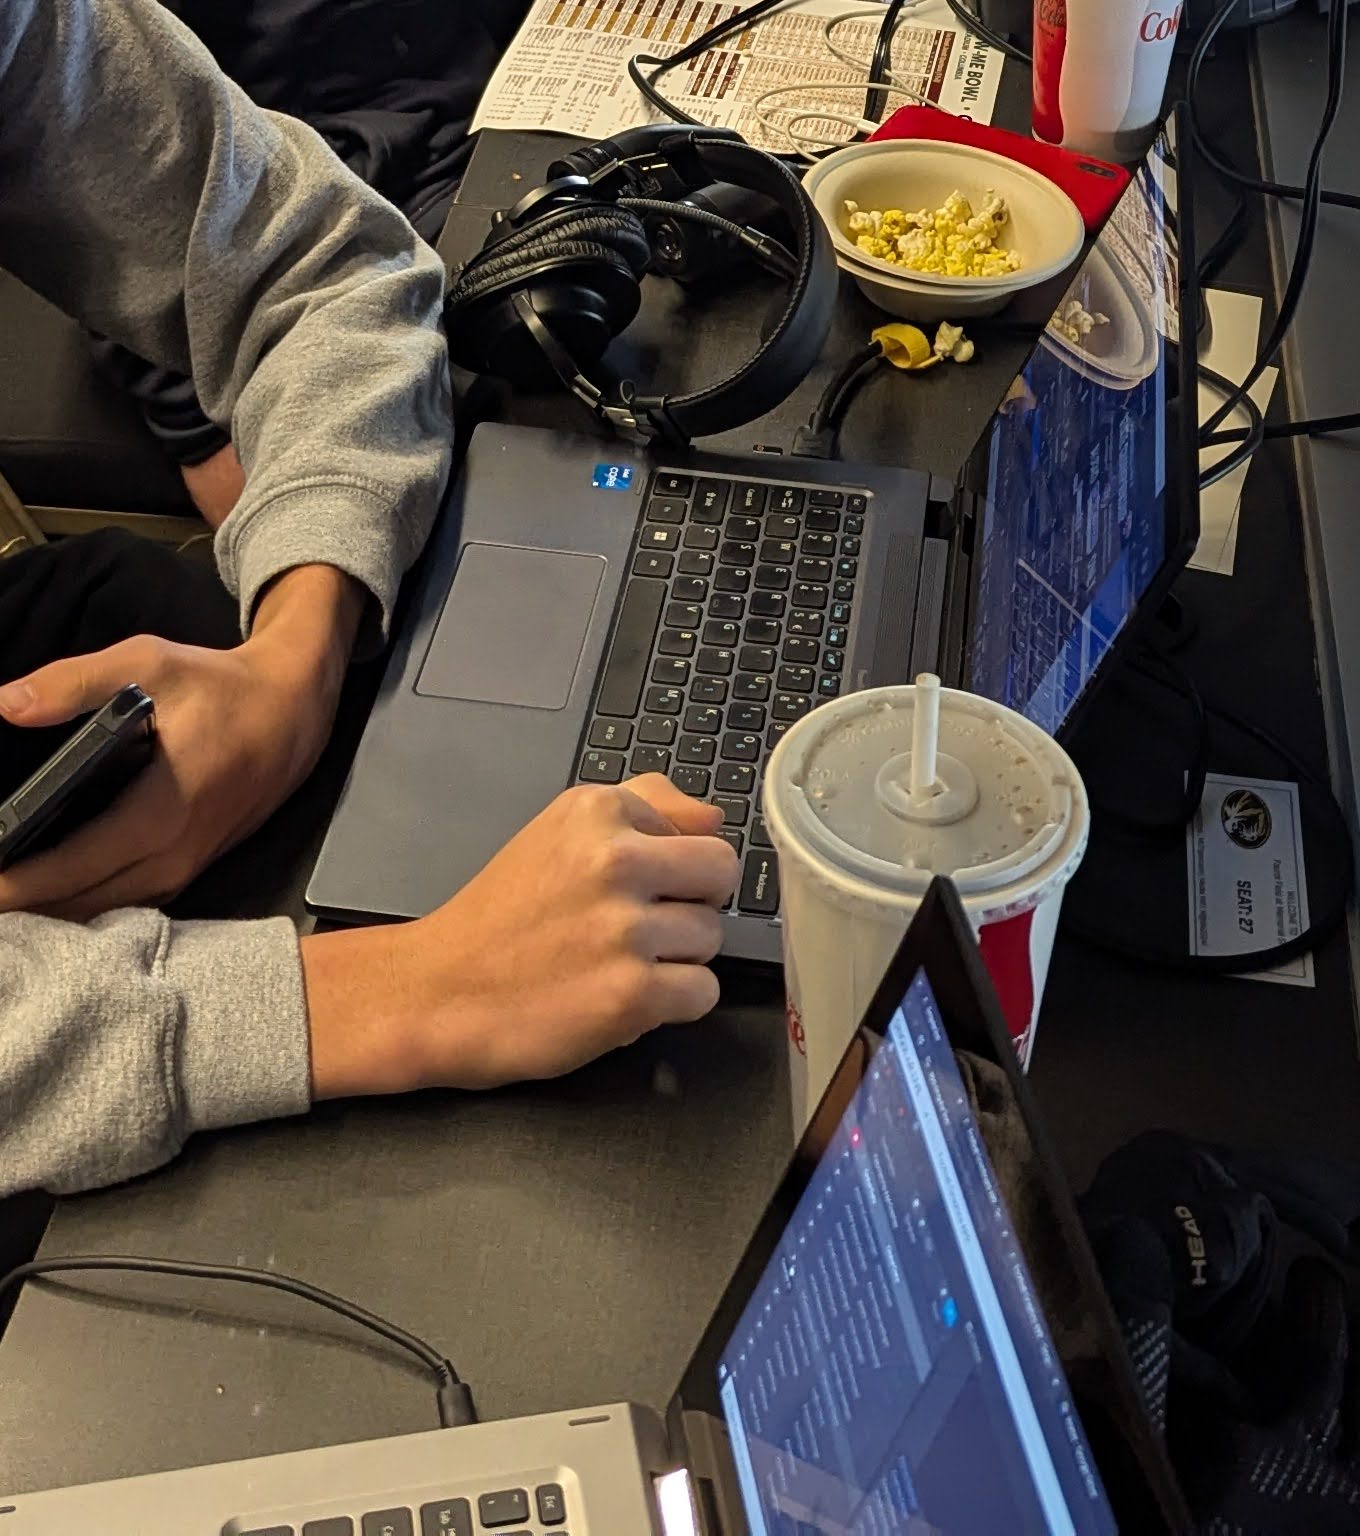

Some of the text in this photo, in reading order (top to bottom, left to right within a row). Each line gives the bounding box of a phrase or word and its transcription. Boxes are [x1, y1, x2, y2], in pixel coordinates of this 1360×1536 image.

[960, 40, 991, 103] W-ME BOWL
[667, 689, 679, 698] M
[1237, 880, 1254, 935] SEAT: 27
[1174, 1206, 1206, 1286] HEAD
